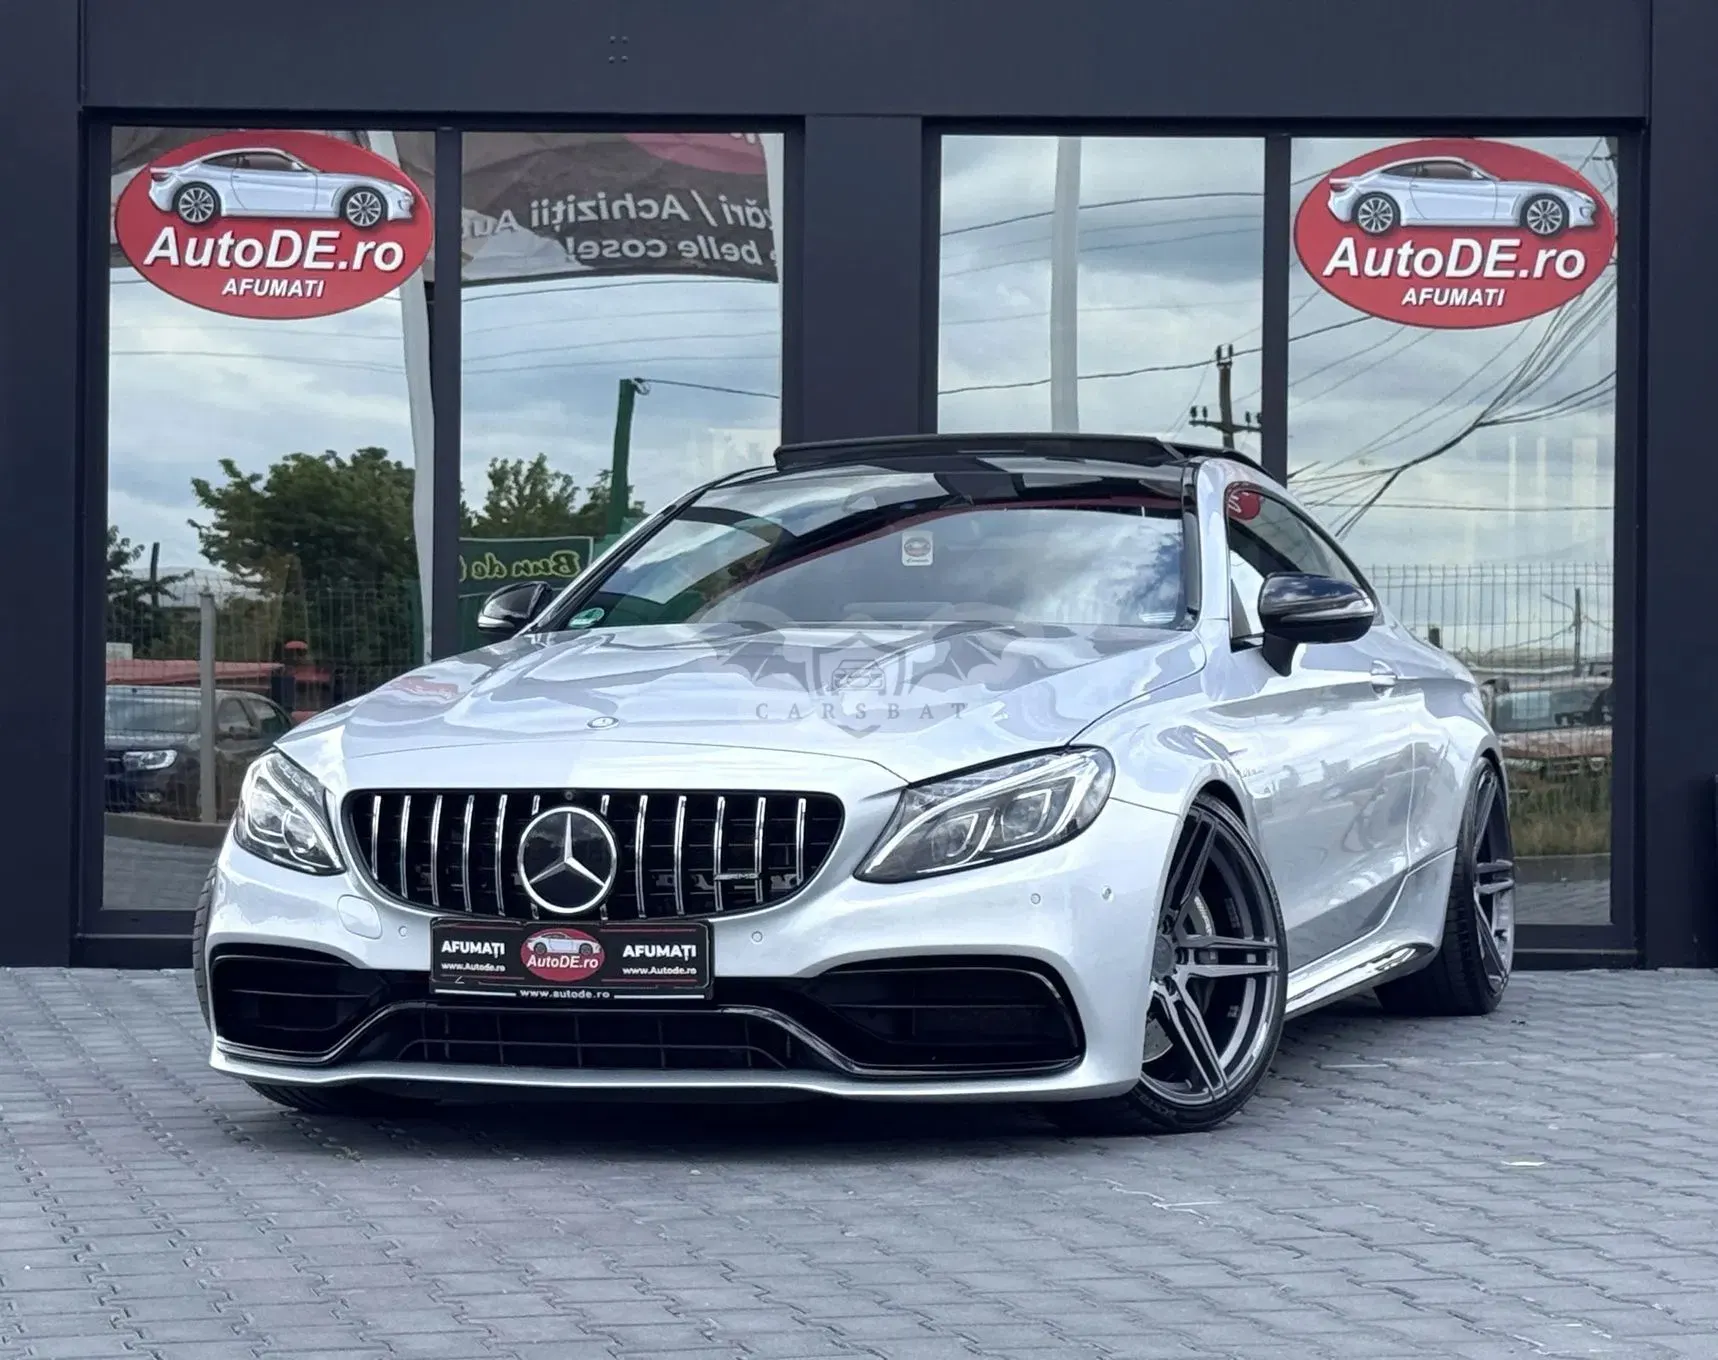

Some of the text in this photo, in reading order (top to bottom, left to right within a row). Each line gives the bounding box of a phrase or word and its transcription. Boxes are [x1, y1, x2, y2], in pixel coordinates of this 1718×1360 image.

[143, 226, 405, 273] AutoDE.ro
[1322, 236, 1587, 280] AutoDE.ro
[221, 278, 325, 299] AFUMATI
[1401, 287, 1506, 307] AFUMATI
[526, 954, 600, 970] AutoDE.ro
[519, 988, 611, 999] www.autode.ro
